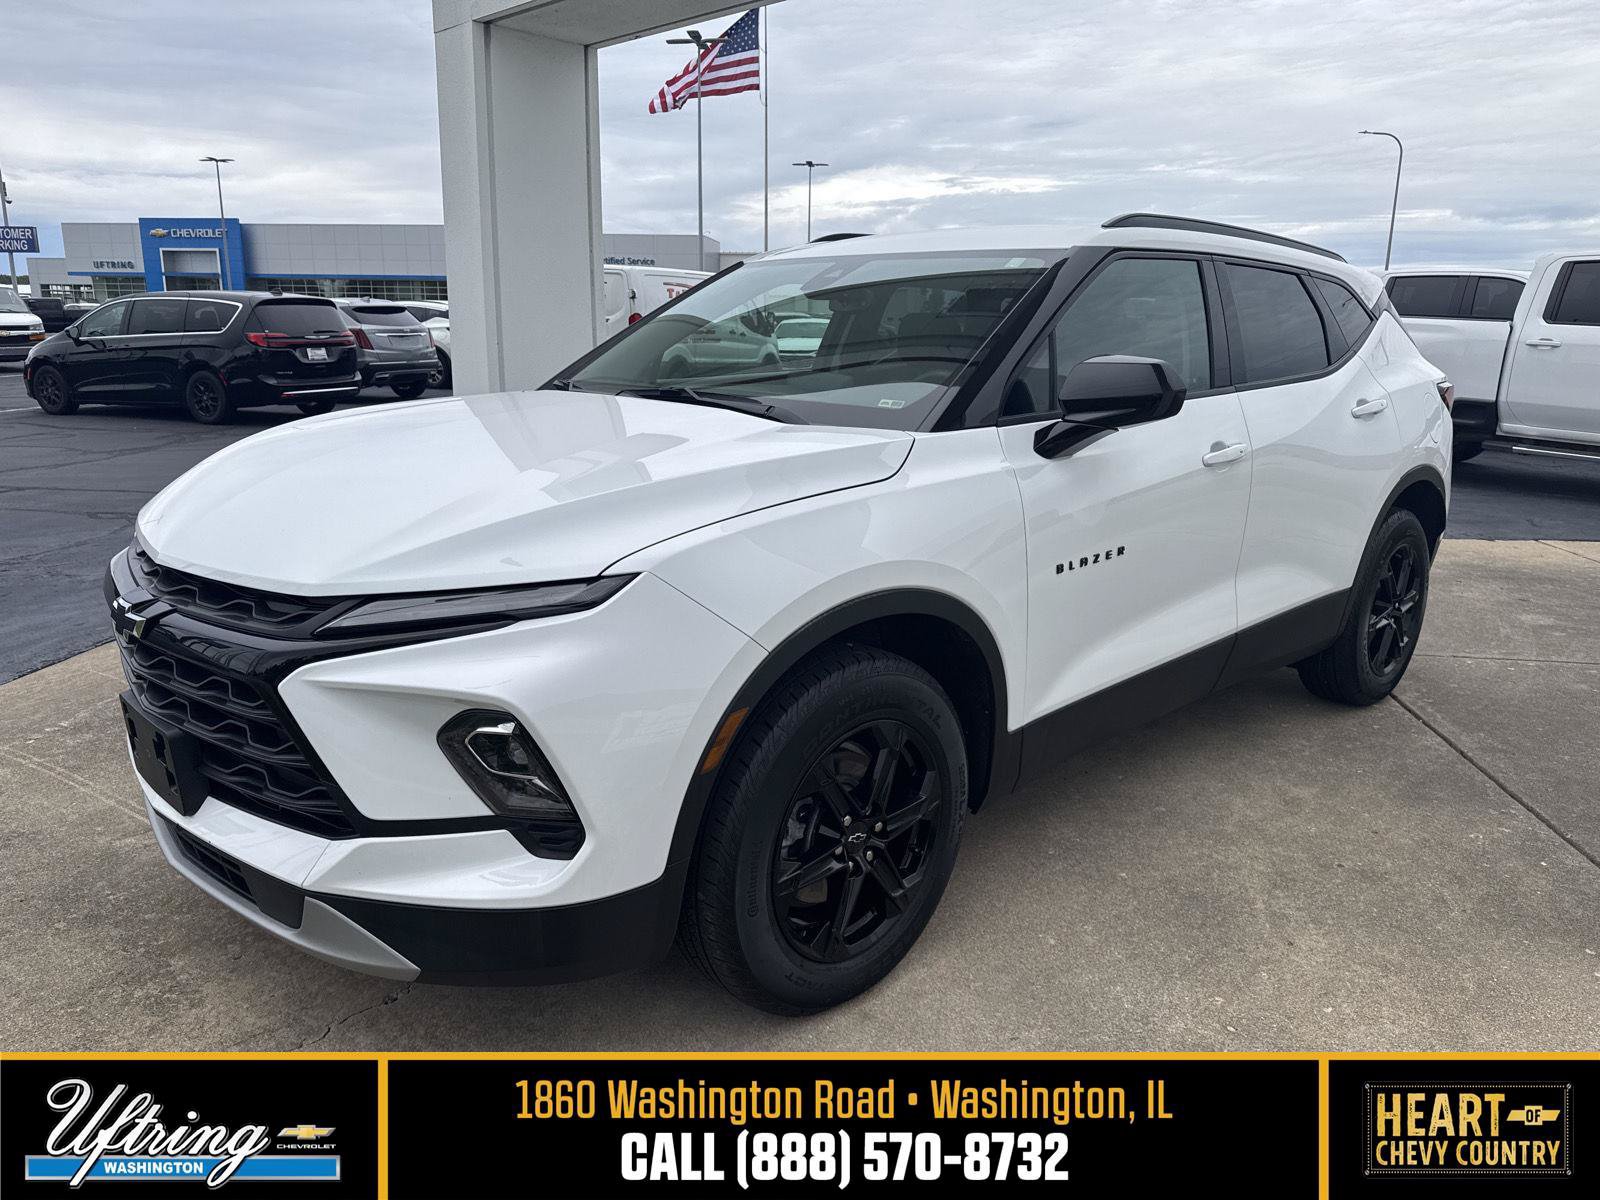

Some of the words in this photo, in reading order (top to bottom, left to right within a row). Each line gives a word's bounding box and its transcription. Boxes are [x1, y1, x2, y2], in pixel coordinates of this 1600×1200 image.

[0, 228, 32, 239] TOMER
[93, 261, 135, 269] UFTRING
[627, 257, 656, 266] Service
[1056, 546, 1125, 575] BLAZER
